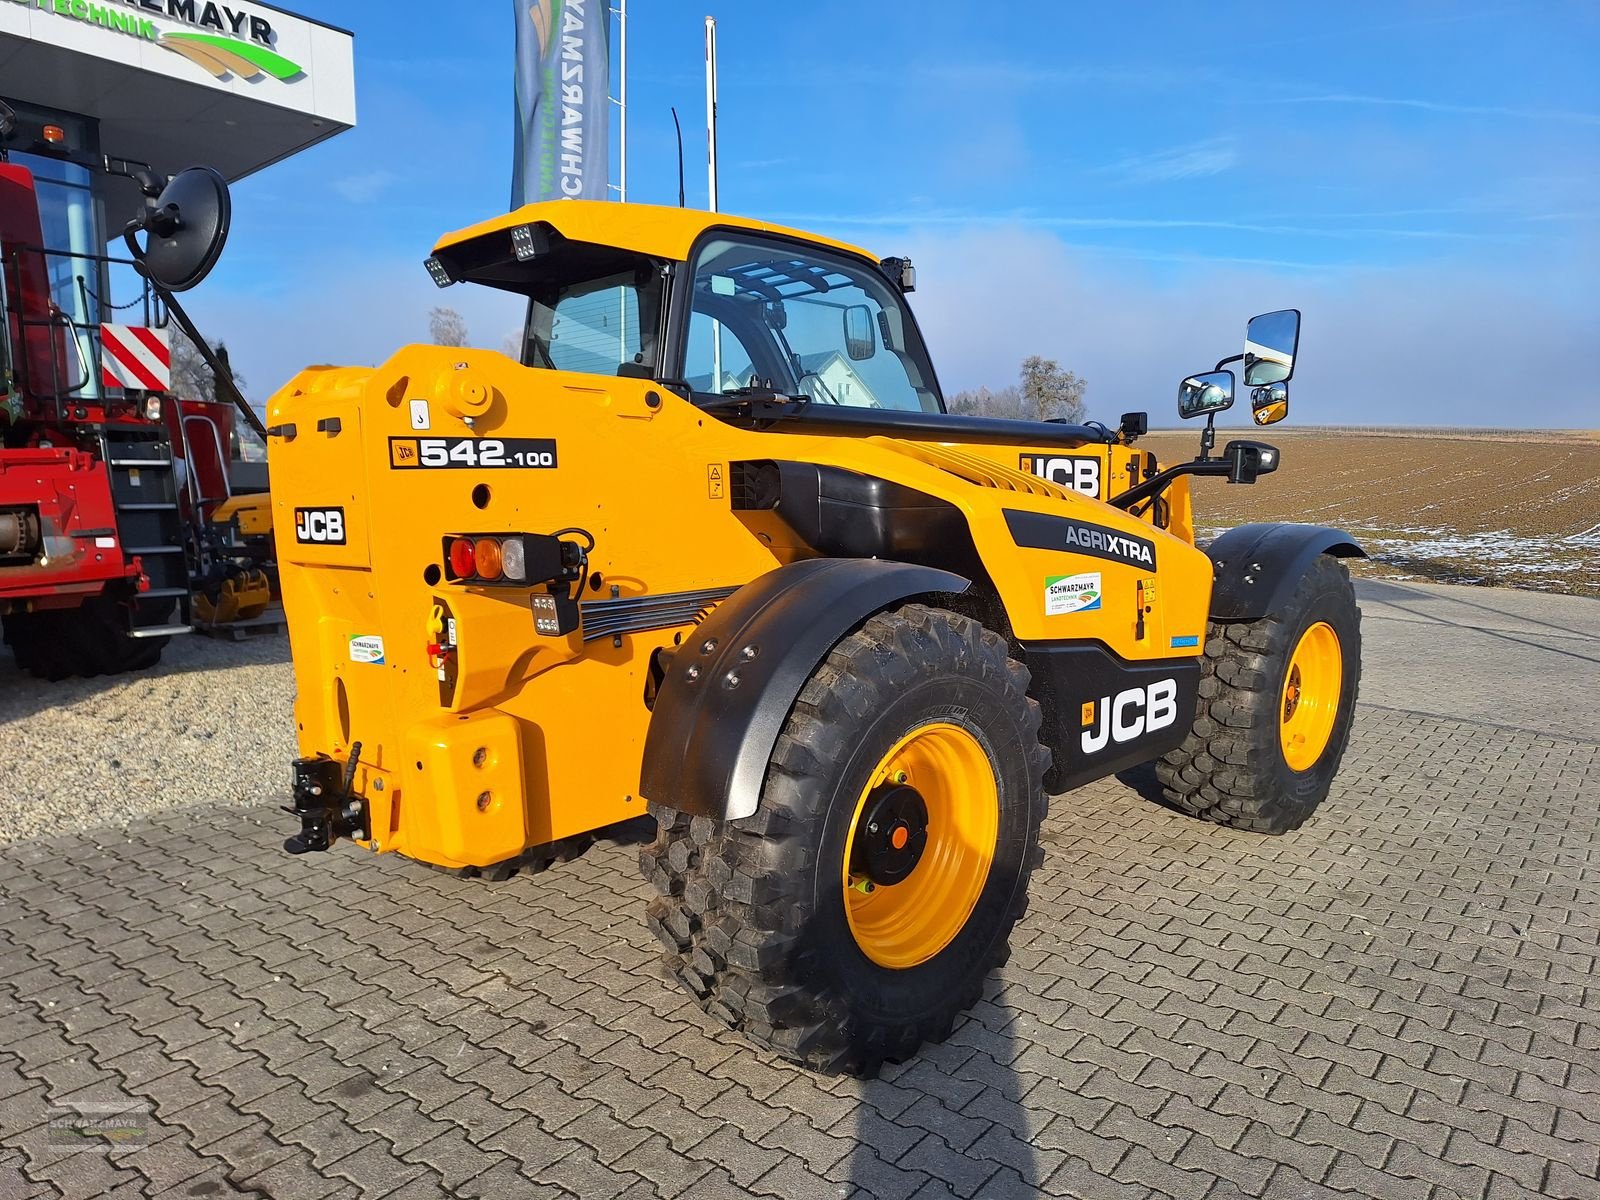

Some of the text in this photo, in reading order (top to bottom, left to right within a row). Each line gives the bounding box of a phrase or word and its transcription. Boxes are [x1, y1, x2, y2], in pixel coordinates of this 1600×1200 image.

[124, 0, 272, 44] MAYR
[297, 511, 344, 541] JCB
[1066, 526, 1152, 564] AGRIXTRA
[1050, 582, 1094, 594] SCHWARZMAYR
[1081, 678, 1177, 754] JCB
